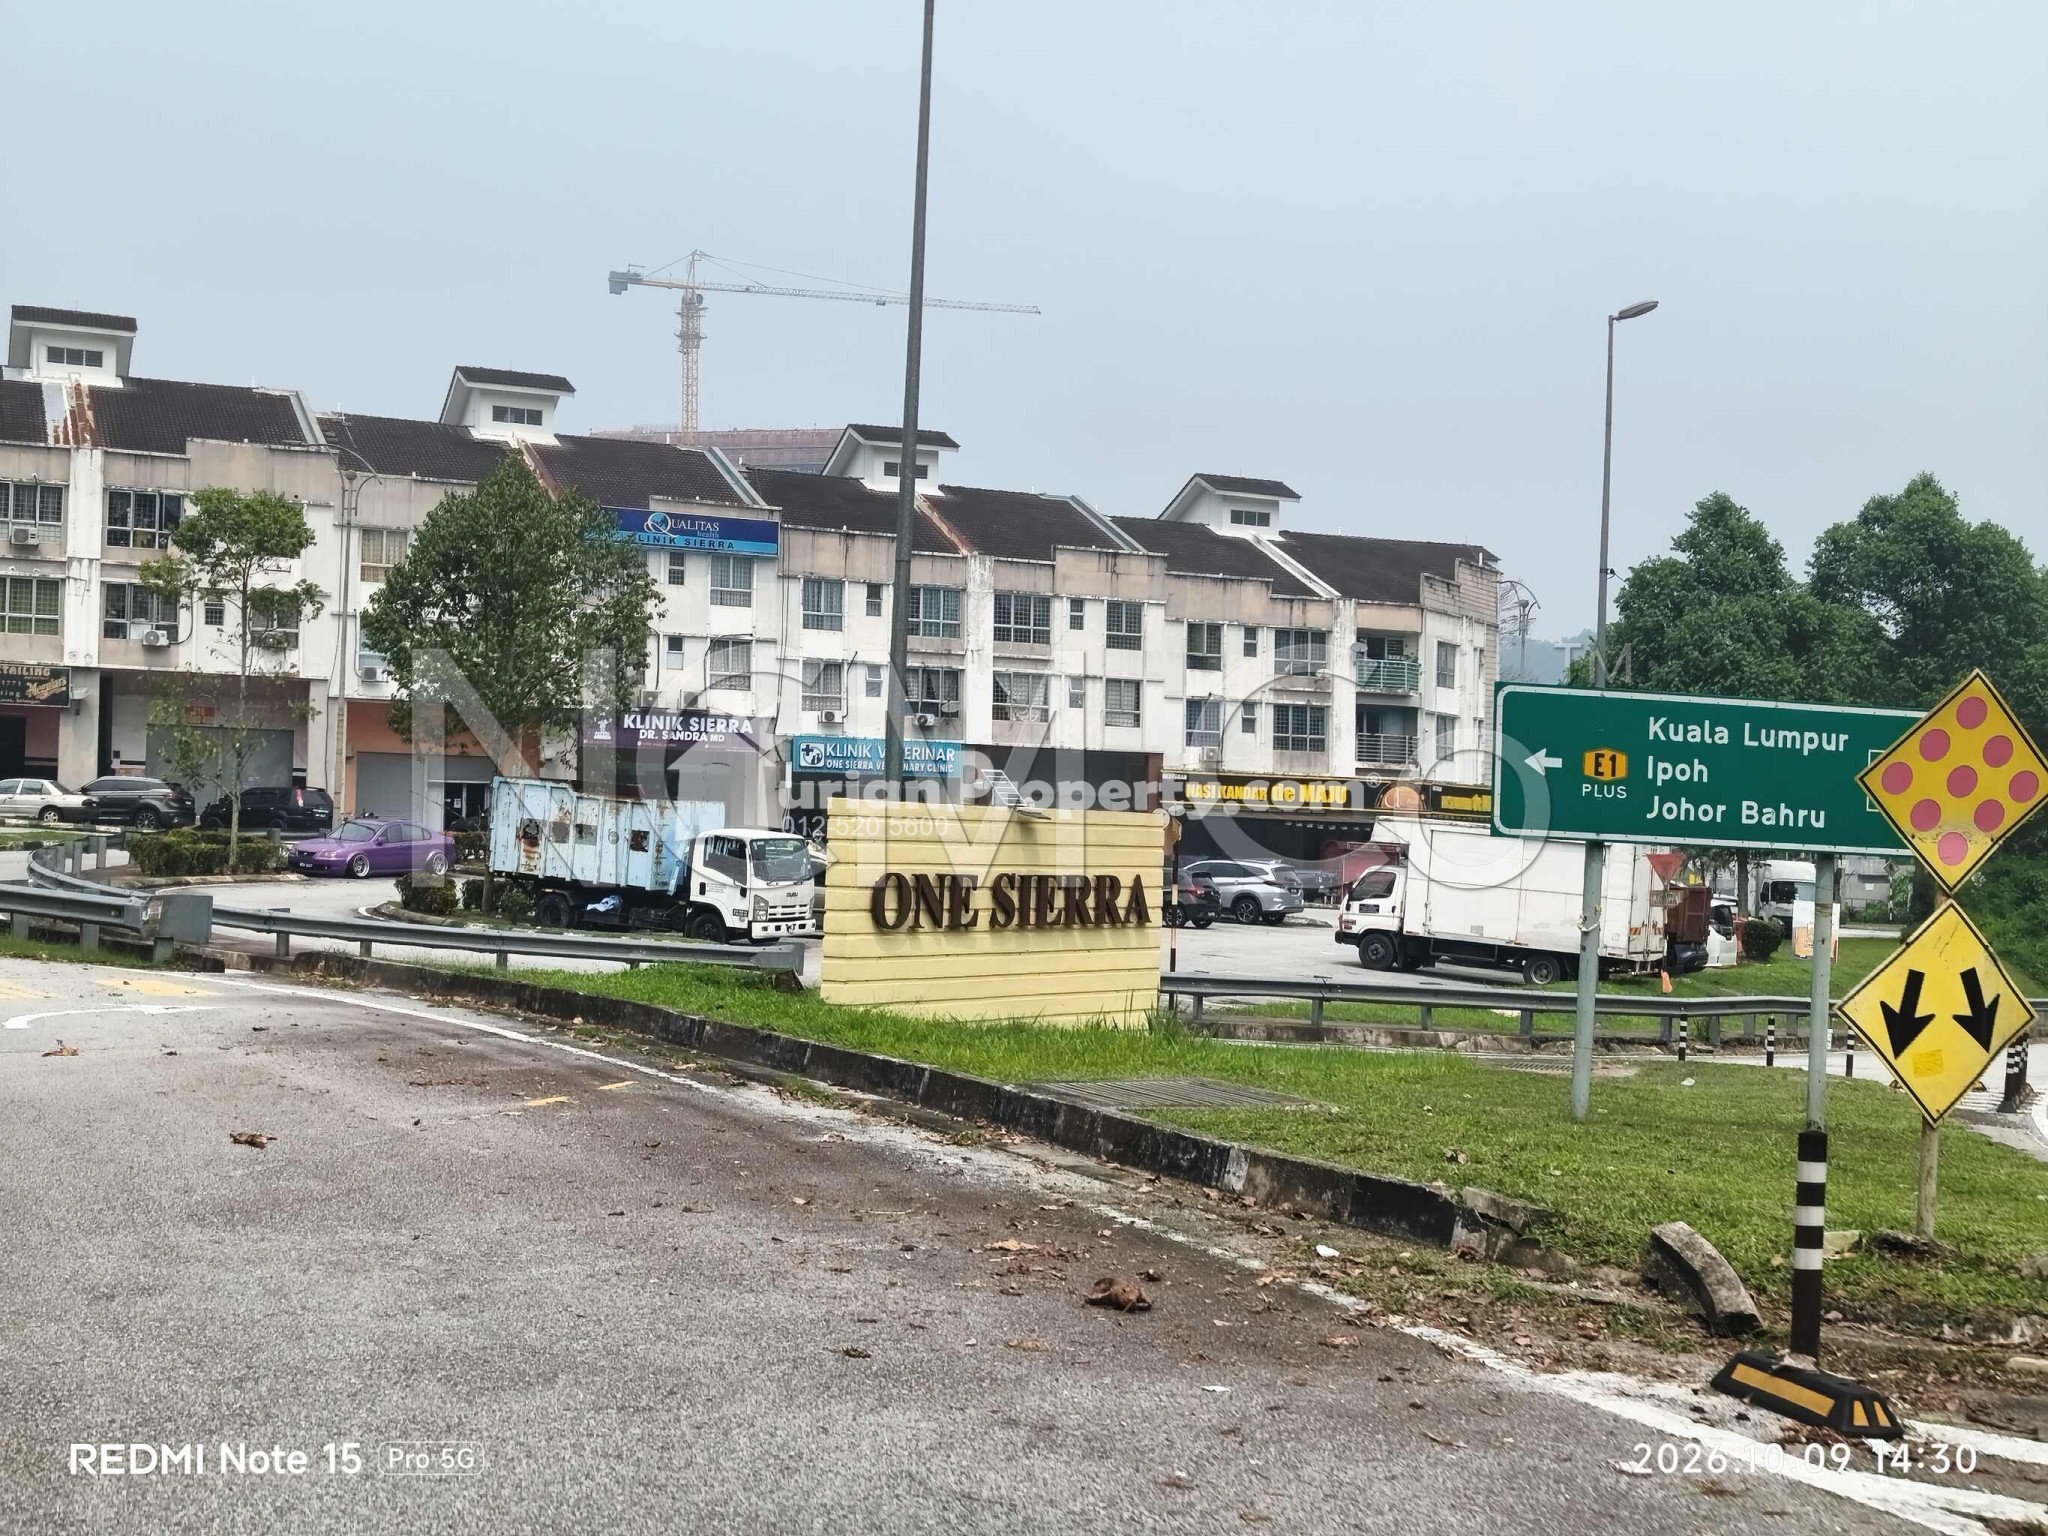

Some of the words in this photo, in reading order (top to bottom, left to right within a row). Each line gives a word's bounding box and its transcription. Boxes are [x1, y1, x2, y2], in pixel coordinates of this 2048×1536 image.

[637, 534, 677, 545] LINIK
[684, 537, 735, 549] SIERRA
[0, 665, 51, 676] TAILING
[623, 714, 684, 731] KLINIK
[689, 717, 753, 734] SIERRA
[639, 729, 658, 740] DR.
[662, 730, 708, 742] SANDRA
[710, 734, 725, 742] MD
[1648, 716, 1729, 744] Kuala
[1743, 723, 1849, 755] Lumpur
[826, 743, 872, 759] KLINIK
[877, 744, 956, 762] VERINAR
[826, 759, 844, 768] ONE
[845, 760, 874, 770] SIERRA
[927, 764, 954, 773] CLINIC
[1593, 753, 1617, 777] E1
[1647, 756, 1709, 786] Ipoh
[1185, 783, 1216, 799] NASI
[1218, 784, 1268, 801] KANDAR
[1272, 783, 1295, 802] de
[1299, 784, 1348, 804] MAJU
[1582, 784, 1627, 798] PLUS
[1646, 796, 1727, 822] Johor
[1741, 801, 1825, 828] Bahru
[871, 872, 980, 930] ONE
[988, 872, 1152, 929] SIERRA
